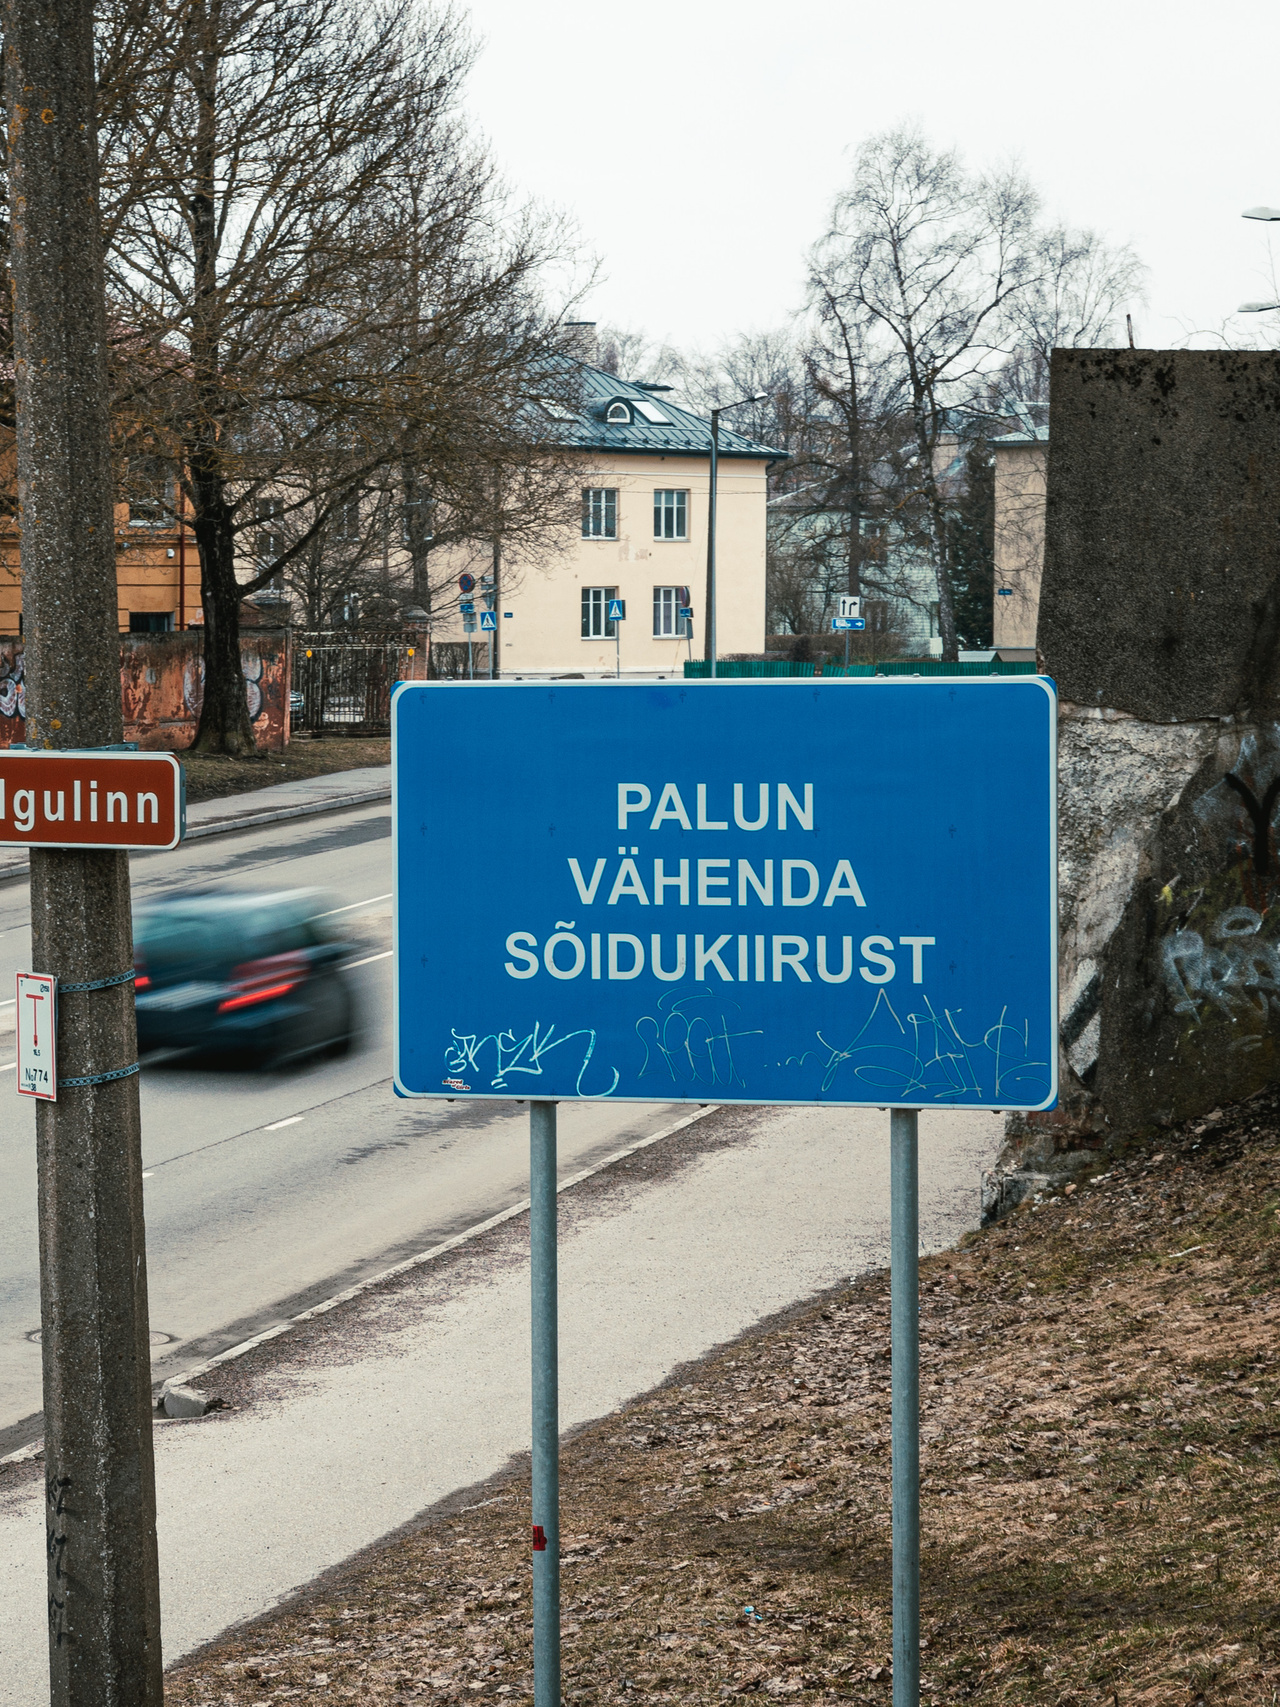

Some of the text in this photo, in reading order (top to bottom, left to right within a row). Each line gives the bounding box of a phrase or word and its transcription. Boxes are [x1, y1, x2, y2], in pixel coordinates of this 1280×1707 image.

[618, 783, 814, 830] PALUN
[567, 846, 867, 907] VÄHENDA
[504, 921, 936, 984] SÕIDUKIIRUST
